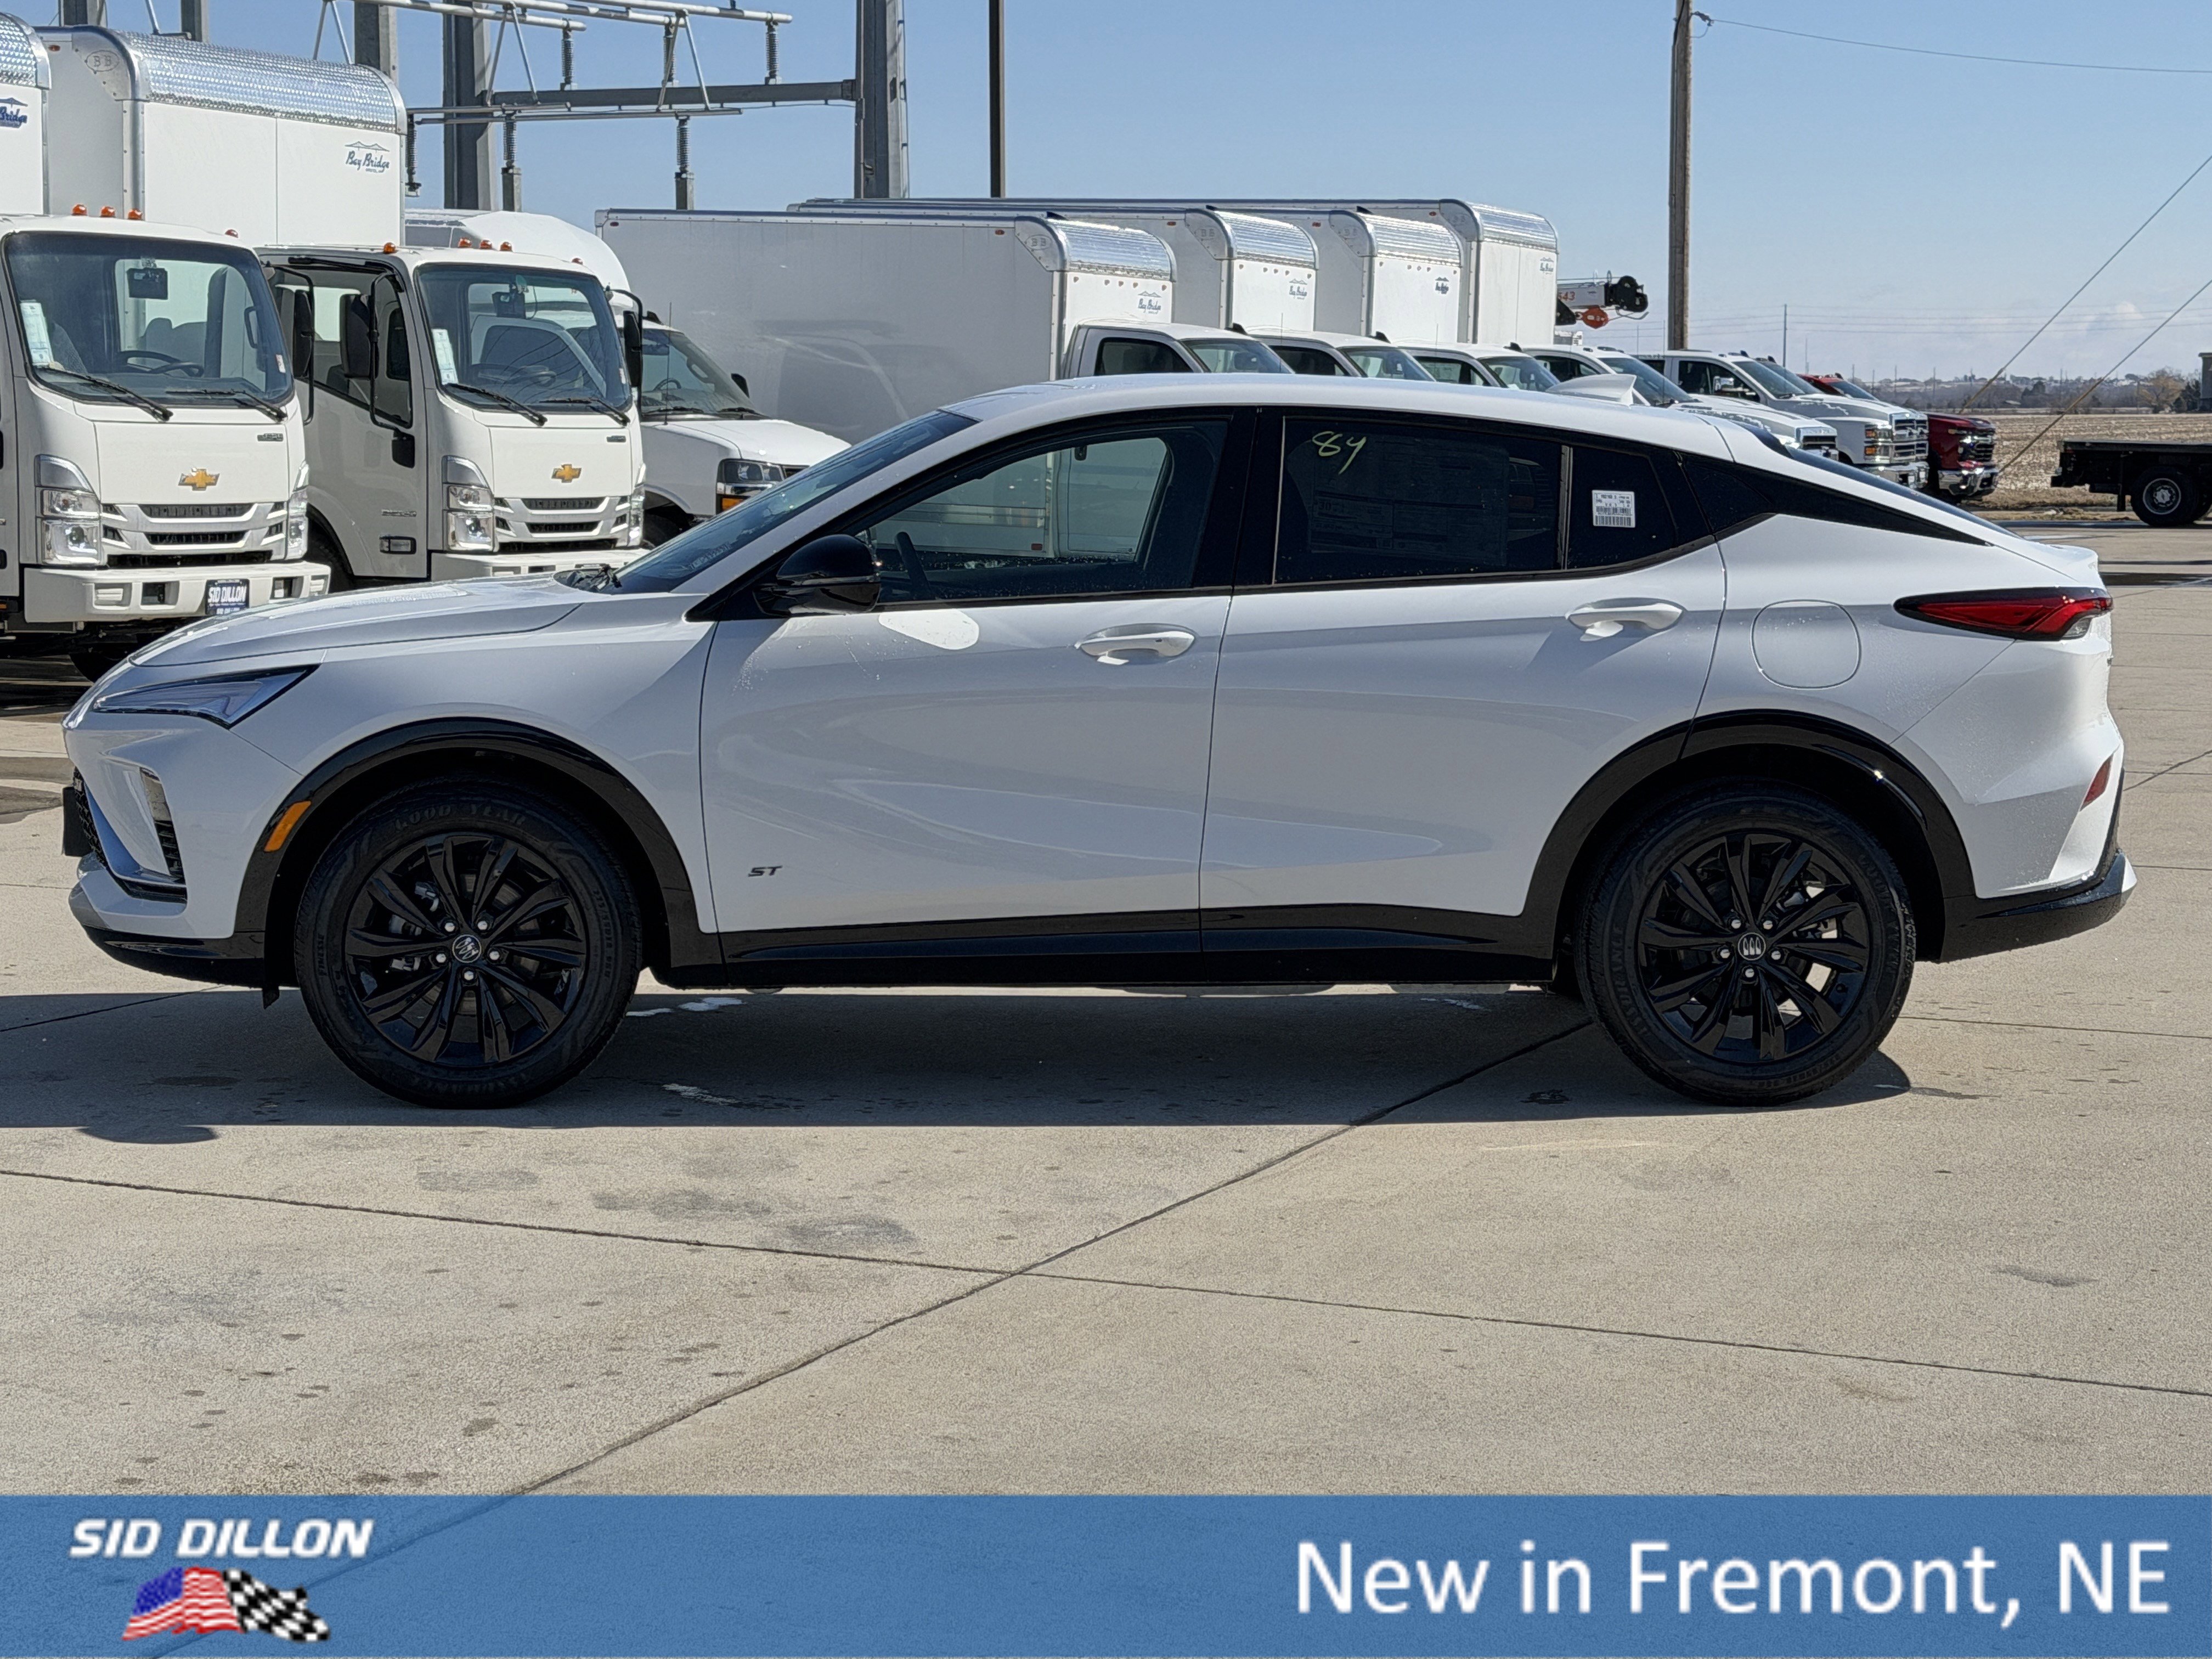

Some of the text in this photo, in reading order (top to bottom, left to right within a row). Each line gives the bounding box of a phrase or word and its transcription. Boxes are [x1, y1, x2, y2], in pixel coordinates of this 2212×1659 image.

[345, 150, 390, 173] Bay Bridge
[208, 585, 247, 603] SID DILLON
[748, 865, 783, 877] ST
